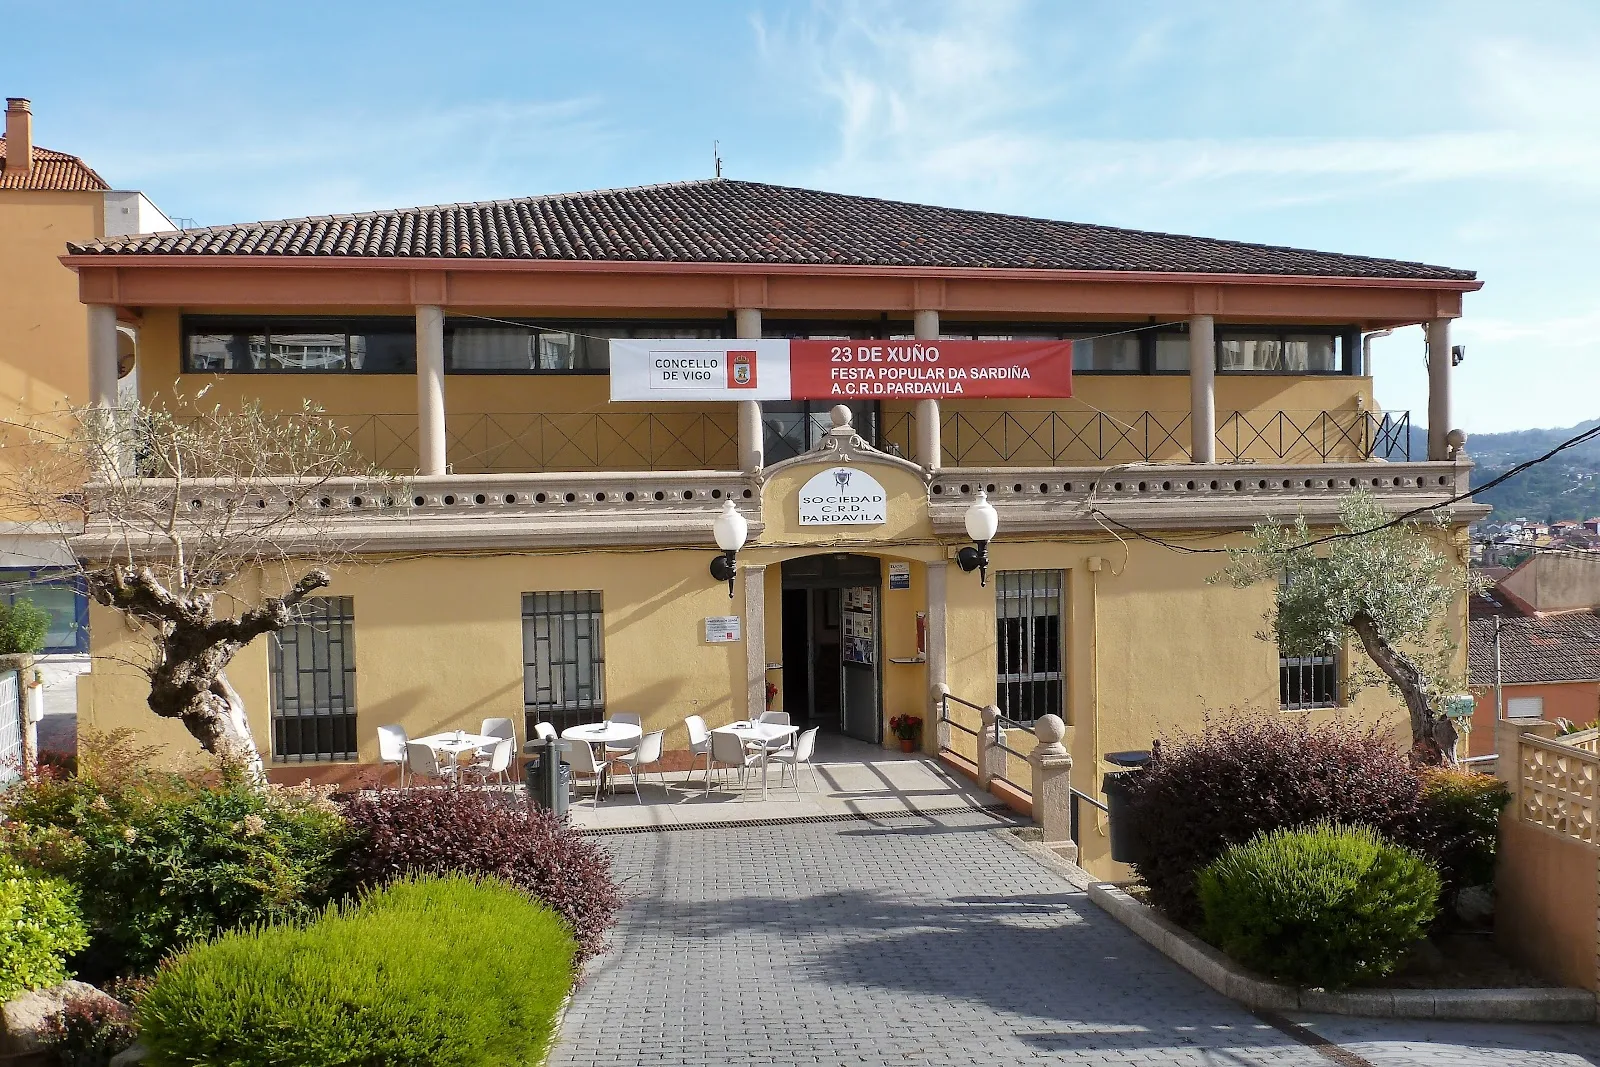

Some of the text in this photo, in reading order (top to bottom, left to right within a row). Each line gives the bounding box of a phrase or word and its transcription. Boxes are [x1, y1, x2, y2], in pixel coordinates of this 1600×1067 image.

[830, 344, 940, 363] 23 DE XUÑO
[655, 359, 718, 369] CONCELLO
[663, 371, 711, 381] DE VIGO
[831, 365, 1031, 380] FESTA POPULAR DA SARDIÑA
[803, 496, 882, 504] SOCIEDAD
[821, 505, 865, 513] C.R.D.
[802, 514, 883, 522] PARDAVILA
